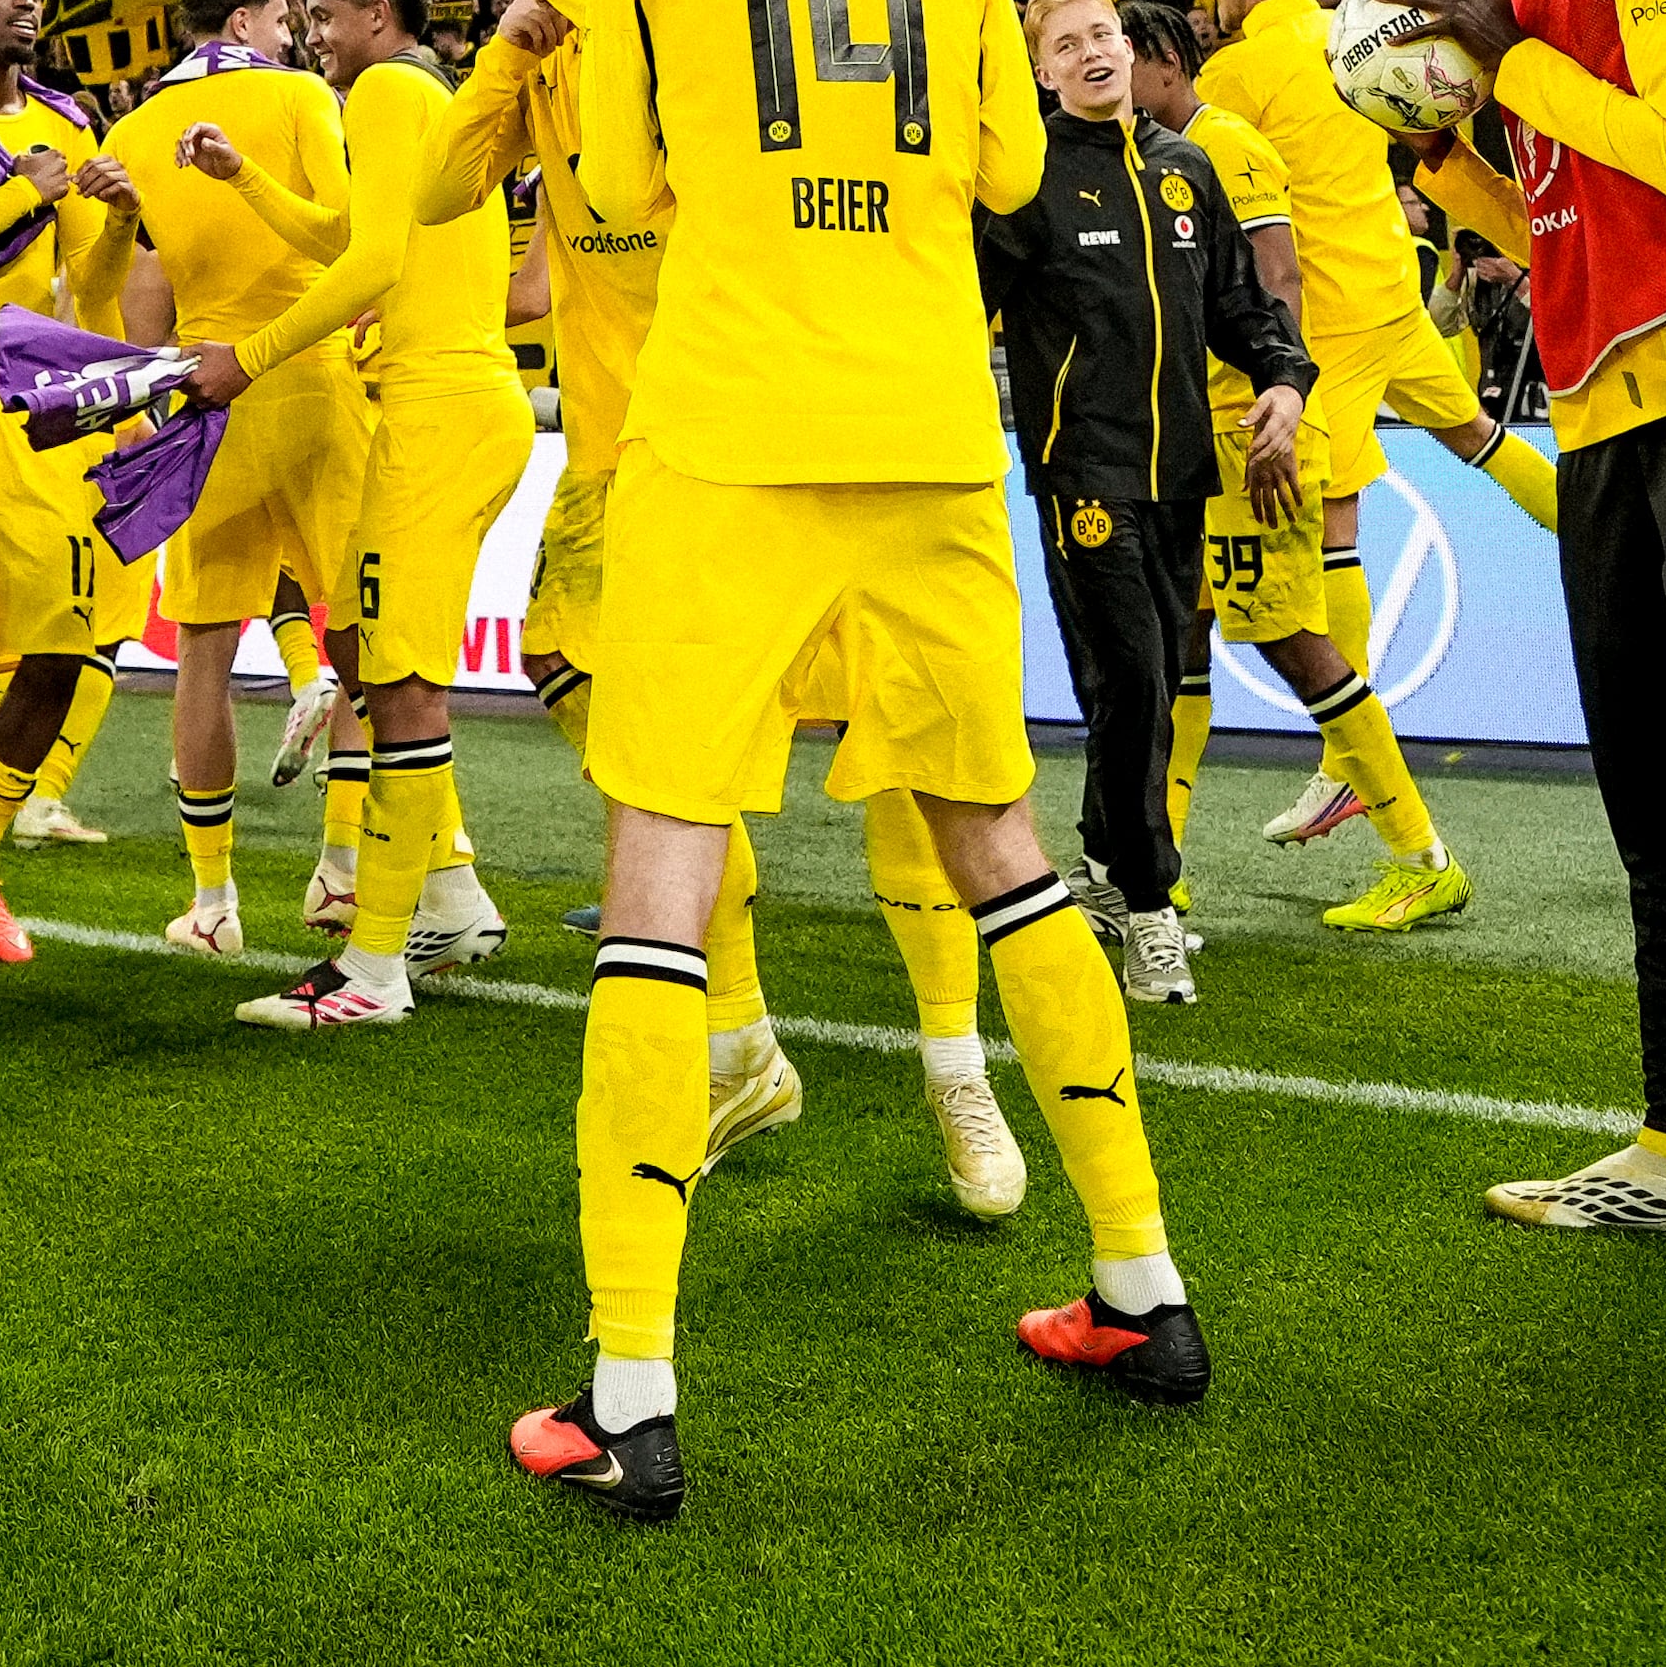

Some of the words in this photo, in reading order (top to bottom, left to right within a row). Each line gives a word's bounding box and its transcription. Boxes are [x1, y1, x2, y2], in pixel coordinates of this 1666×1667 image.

[1341, 6, 1426, 73] DERBYSTAR
[791, 177, 891, 234] BEIER
[1165, 179, 1190, 201] BVB
[1531, 204, 1579, 237] OKAL
[1078, 230, 1120, 246] REWE
[1076, 514, 1107, 536] BVB
[1209, 534, 1266, 593] 39
